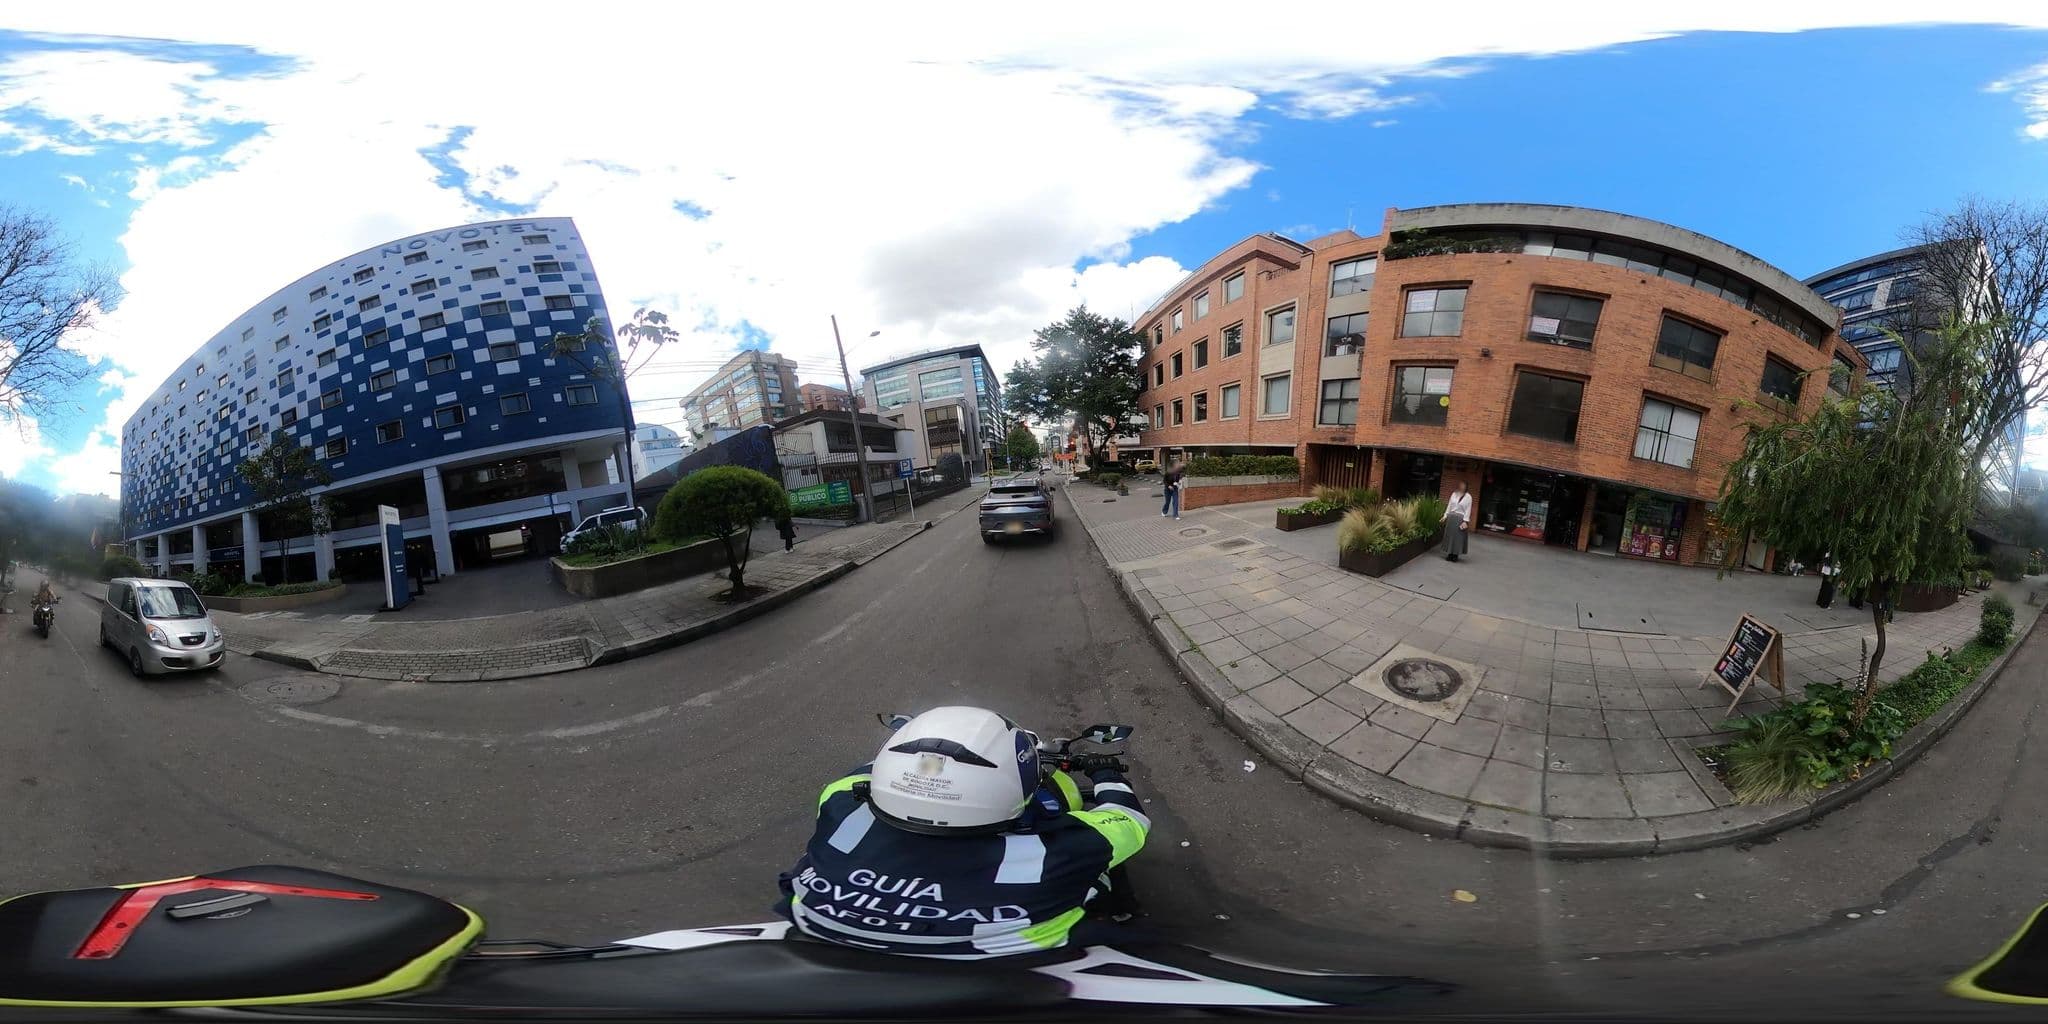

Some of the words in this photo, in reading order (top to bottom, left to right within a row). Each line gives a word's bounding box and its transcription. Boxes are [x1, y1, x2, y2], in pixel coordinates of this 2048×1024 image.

[381, 222, 550, 259] NOVOTEL
[929, 776, 953, 784] MAYOR
[799, 866, 1030, 923] MOVILIDAD
[847, 868, 944, 902] GUÍA
